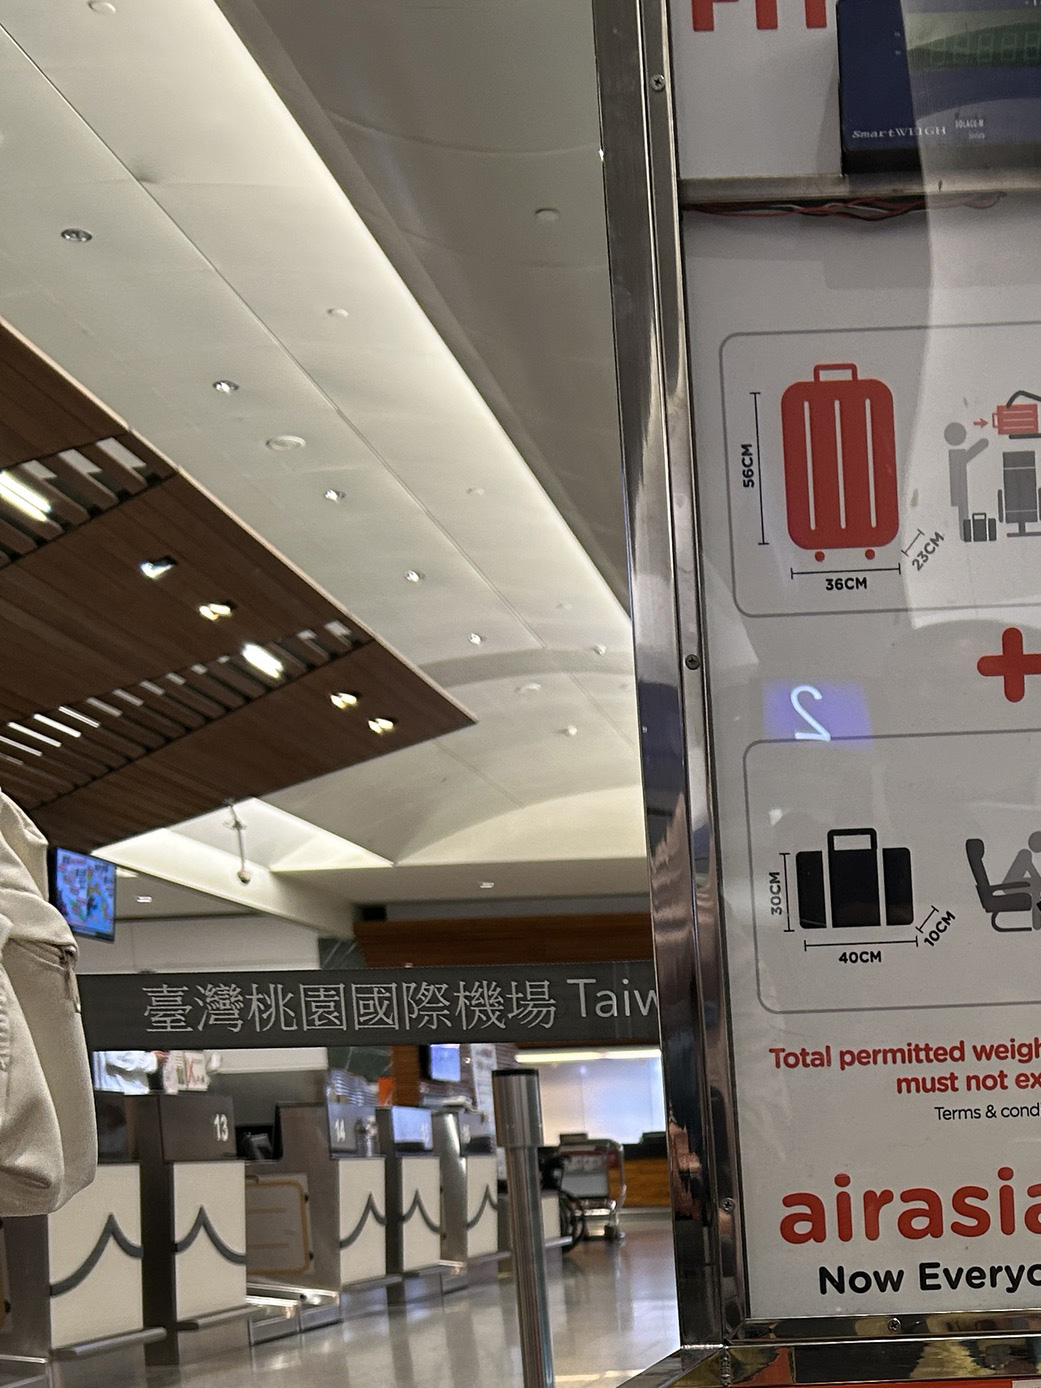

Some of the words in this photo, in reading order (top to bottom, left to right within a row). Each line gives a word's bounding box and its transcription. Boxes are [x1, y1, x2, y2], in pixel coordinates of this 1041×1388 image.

[740, 443, 755, 489] 56CM
[911, 531, 945, 572] 23CM
[825, 576, 868, 591] 36CM
[768, 871, 783, 916] 30CM
[925, 911, 957, 948] 10CM
[838, 950, 882, 964] 40CM
[142, 980, 557, 1034] 臺灣桃園國際機場
[768, 1044, 832, 1070] Total
[839, 1039, 966, 1072] permitted
[896, 1071, 960, 1095] must
[965, 1069, 1009, 1092] not
[213, 1113, 229, 1141] 13
[933, 1106, 982, 1121] Terms
[985, 1104, 998, 1119] &
[818, 1265, 905, 1296] Now
